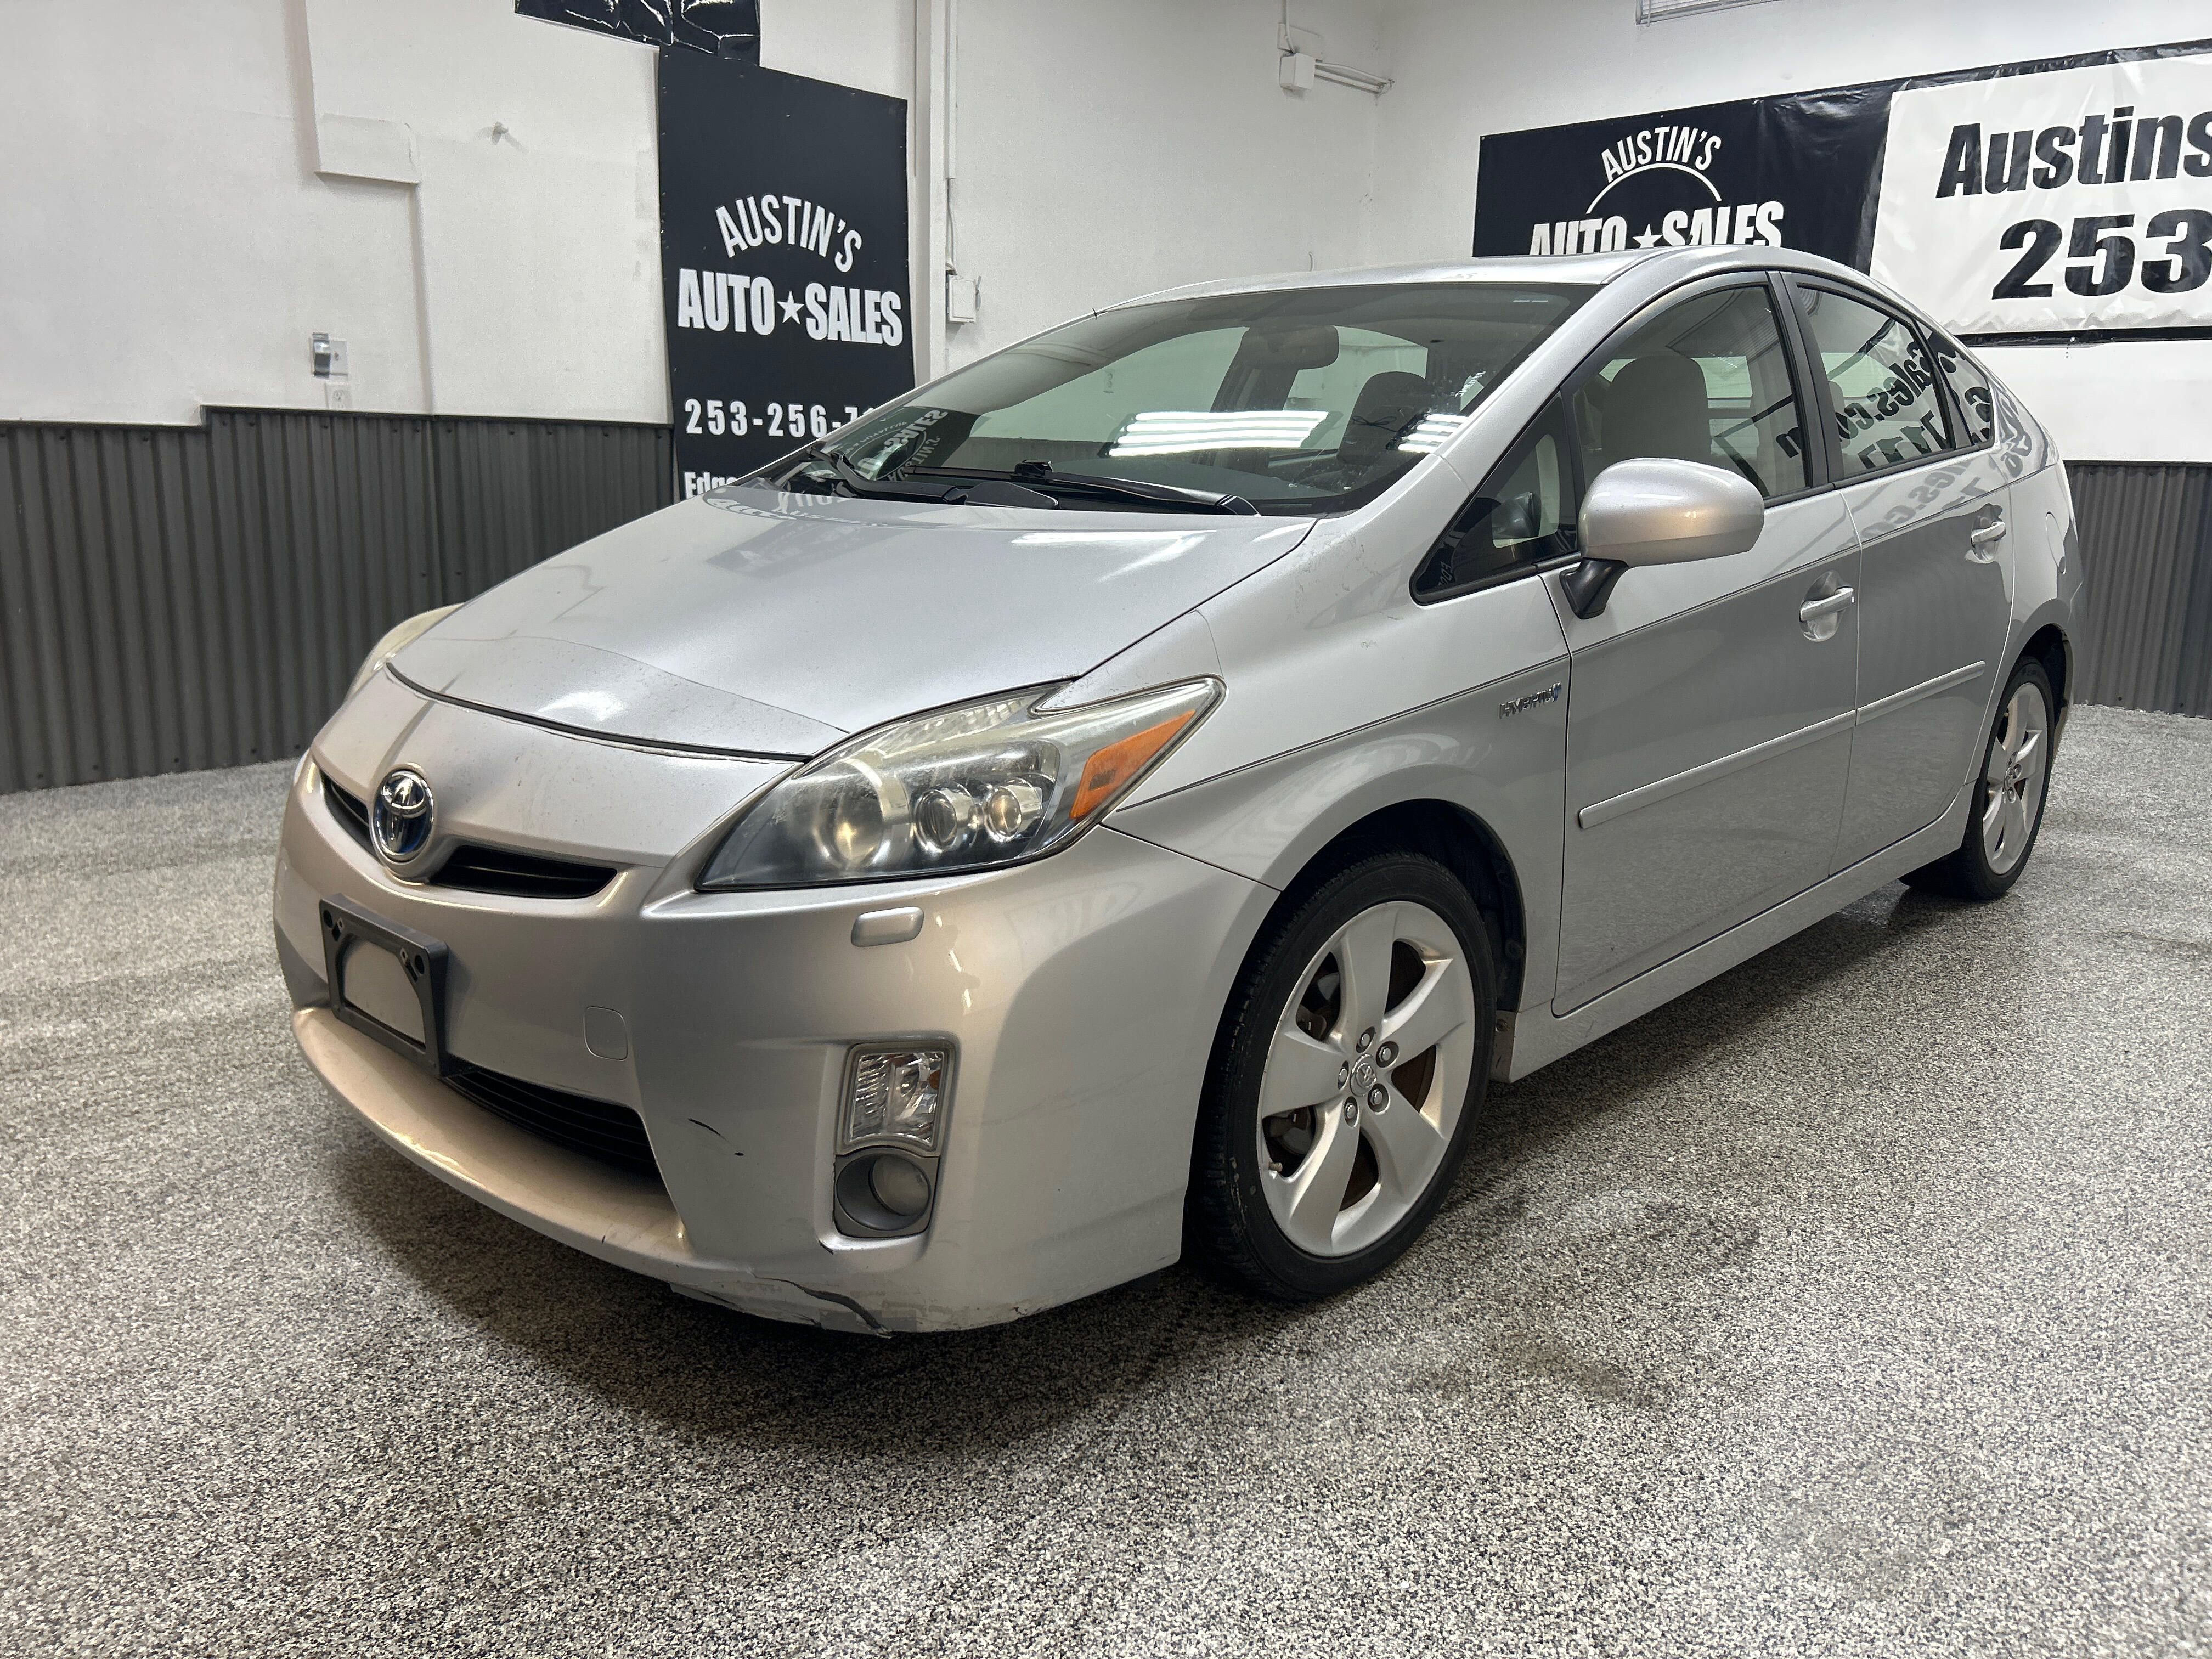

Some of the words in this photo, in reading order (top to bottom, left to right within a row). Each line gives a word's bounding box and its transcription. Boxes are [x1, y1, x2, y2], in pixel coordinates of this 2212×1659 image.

[1601, 125, 1722, 183] AUSTIN'S
[715, 194, 863, 273] AUSTIN'S
[1529, 216, 1628, 256] AUTO
[1661, 201, 1784, 247] SALES
[1991, 208, 2212, 301] 253
[678, 268, 776, 336] AUTO
[805, 282, 904, 347] SALES
[684, 398, 874, 439] 253-256-7
[1498, 686, 1557, 720] HYBRID
